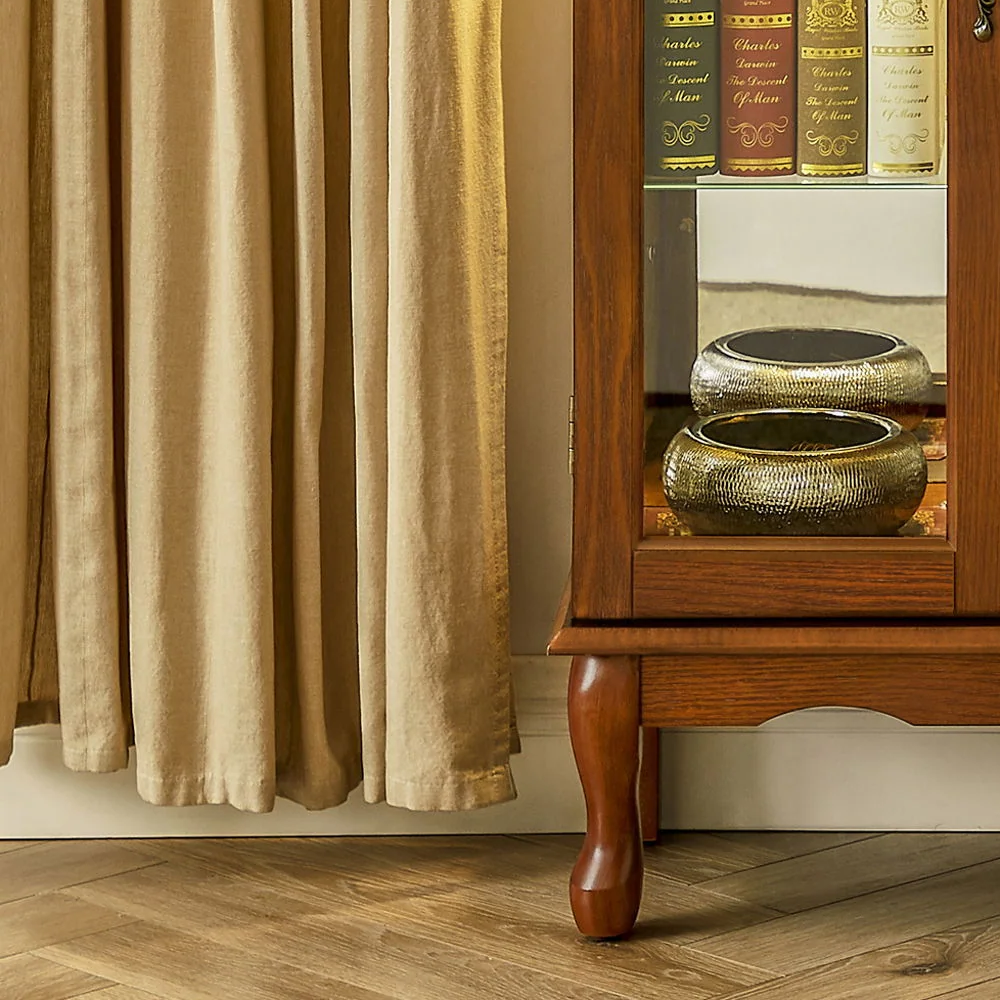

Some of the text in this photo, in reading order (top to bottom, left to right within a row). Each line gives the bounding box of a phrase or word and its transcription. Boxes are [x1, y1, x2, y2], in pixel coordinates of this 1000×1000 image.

[824, 8, 840, 16] RW
[894, 5, 911, 14] RW
[660, 37, 702, 49] harles
[733, 37, 781, 50] Charles
[658, 57, 699, 67] arwin
[735, 58, 777, 68] Darwin
[811, 65, 852, 78] Charles
[882, 65, 922, 75] Charles
[668, 73, 710, 85] Descent
[726, 74, 788, 86] The Descent
[813, 82, 849, 92] Darwin
[669, 90, 702, 102] Man
[733, 90, 780, 108] Of Man
[824, 96, 859, 106] Descent
[811, 109, 851, 125] Of Man
